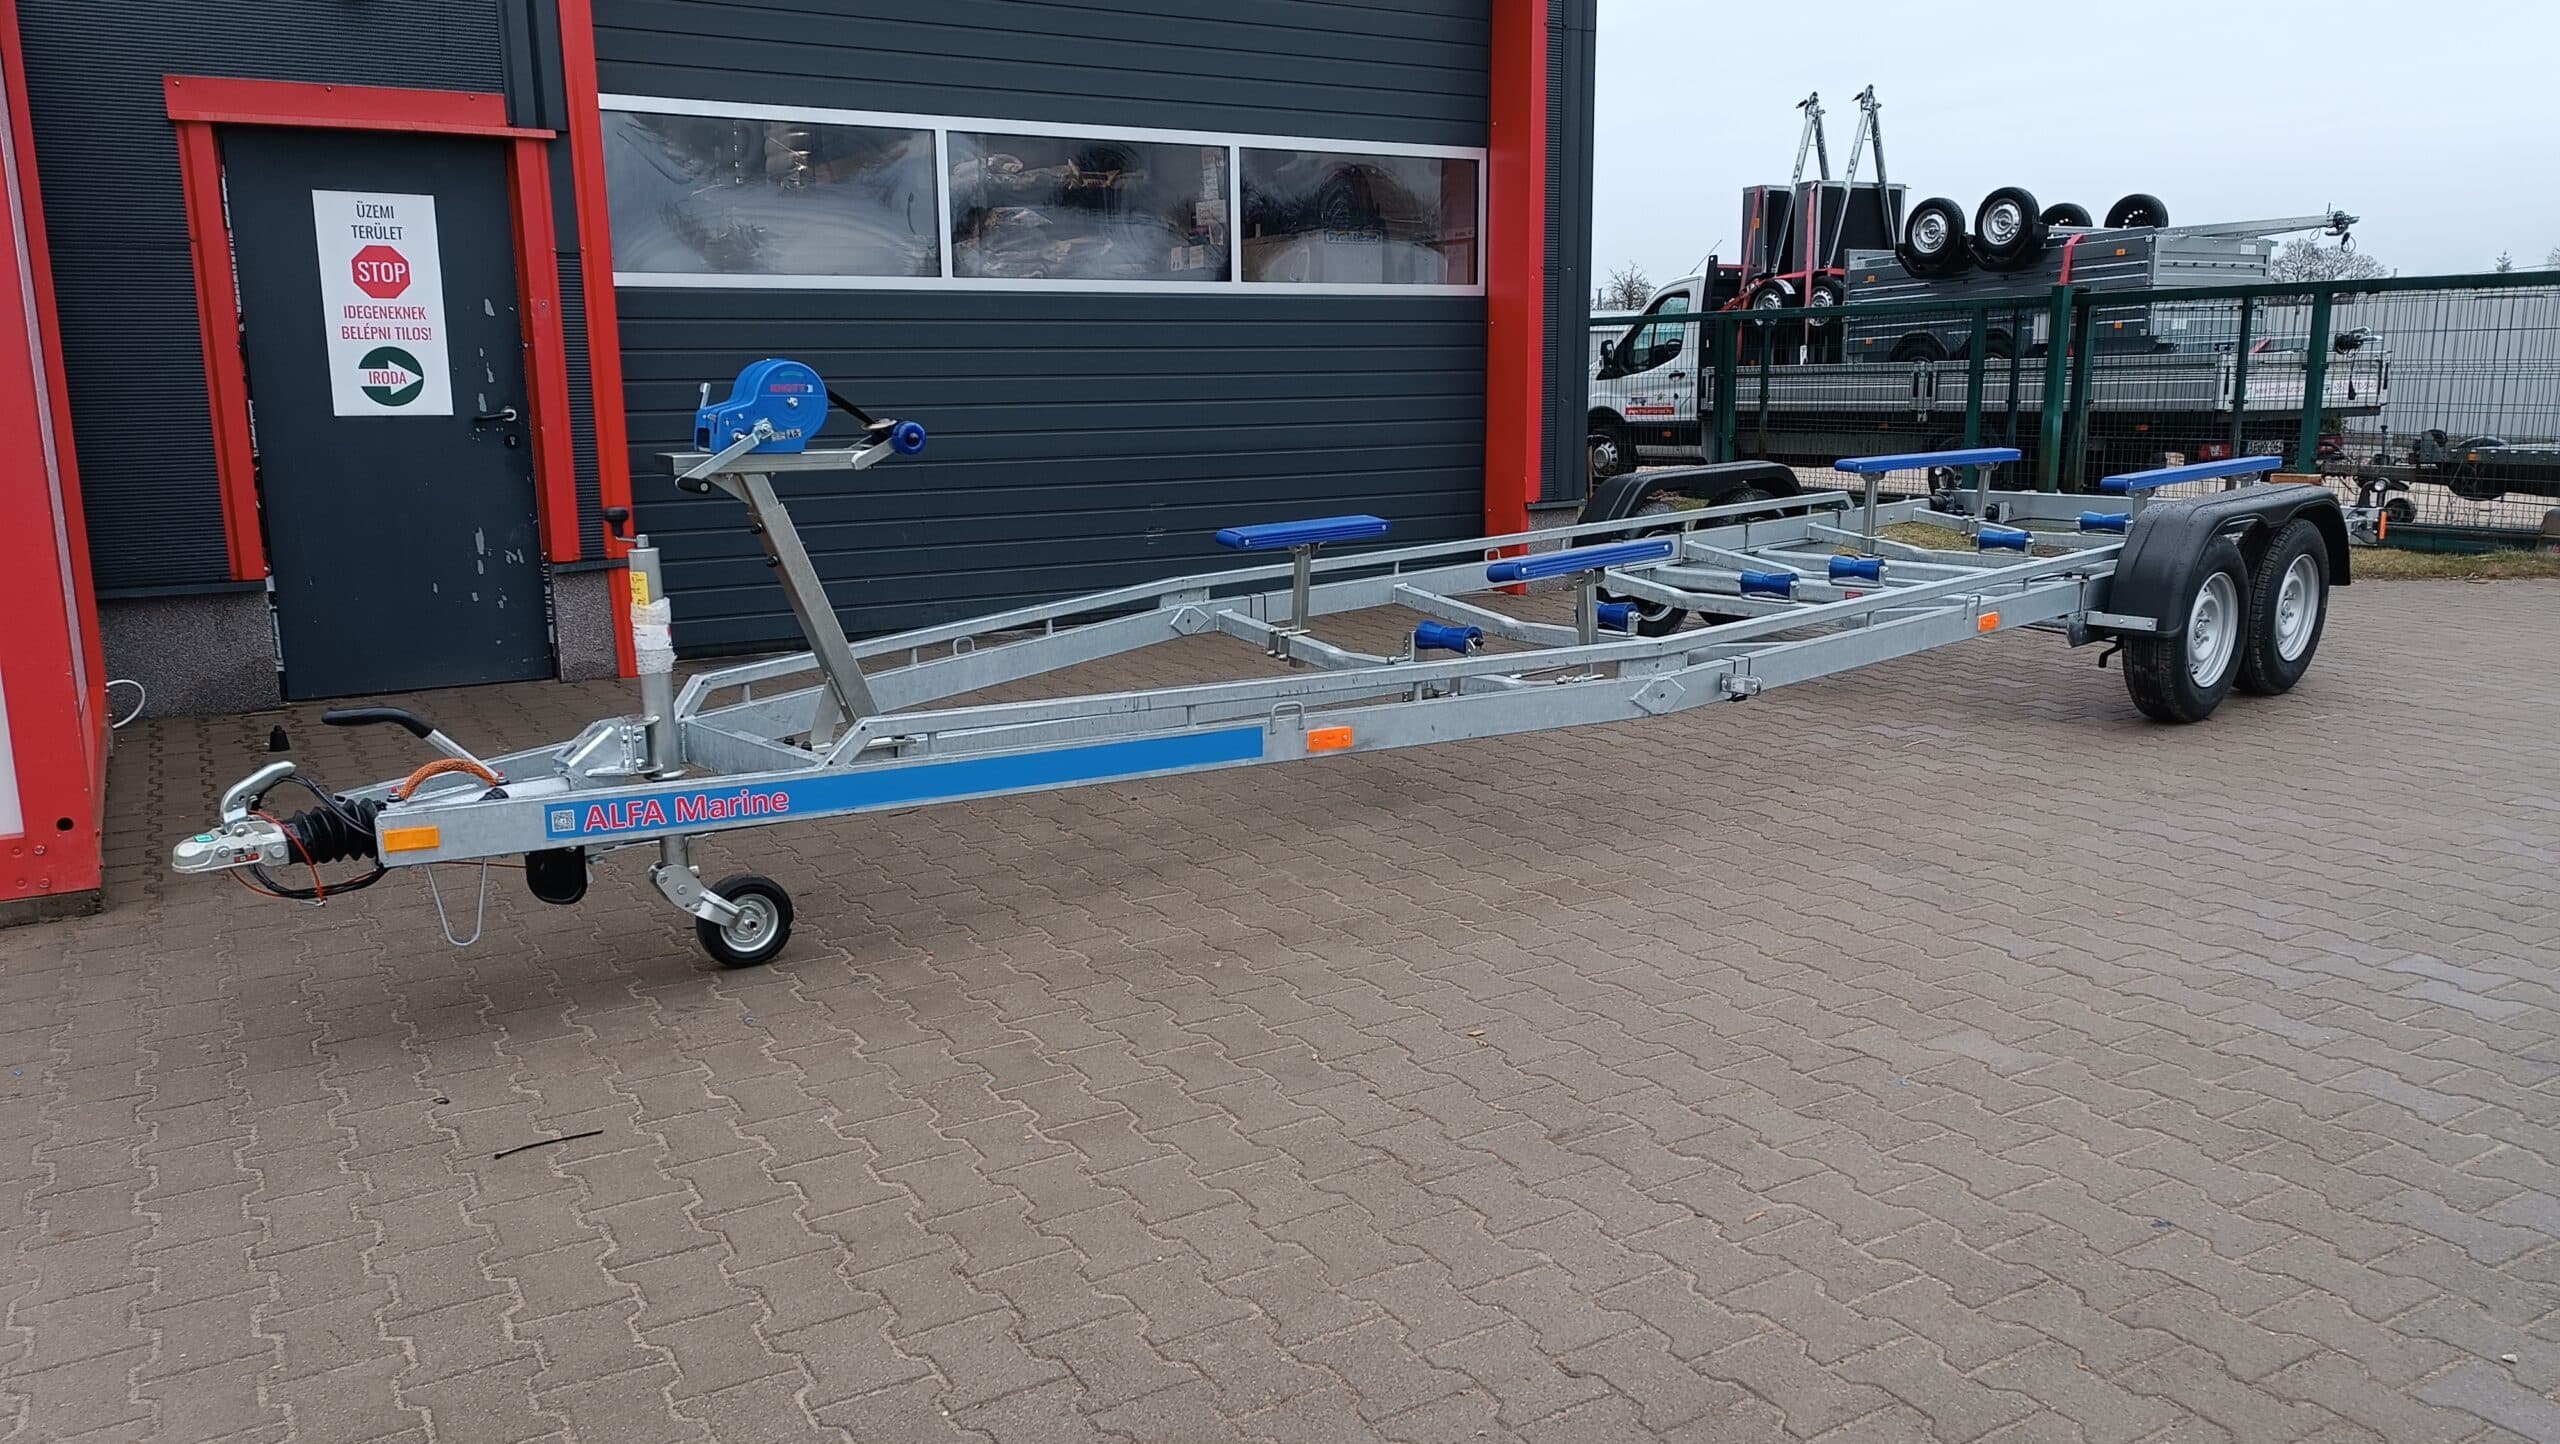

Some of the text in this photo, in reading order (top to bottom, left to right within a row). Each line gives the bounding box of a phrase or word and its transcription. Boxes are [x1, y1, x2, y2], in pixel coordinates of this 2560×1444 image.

[356, 200, 394, 219] ÜZEMI
[350, 222, 403, 240] TERÜLET
[357, 261, 406, 283] STOP
[343, 305, 427, 320] IDEGENEKNEK
[341, 323, 432, 341] BELÉPNI TILOS!
[368, 371, 407, 384] IRODA
[584, 789, 789, 832] ALFA Marine
